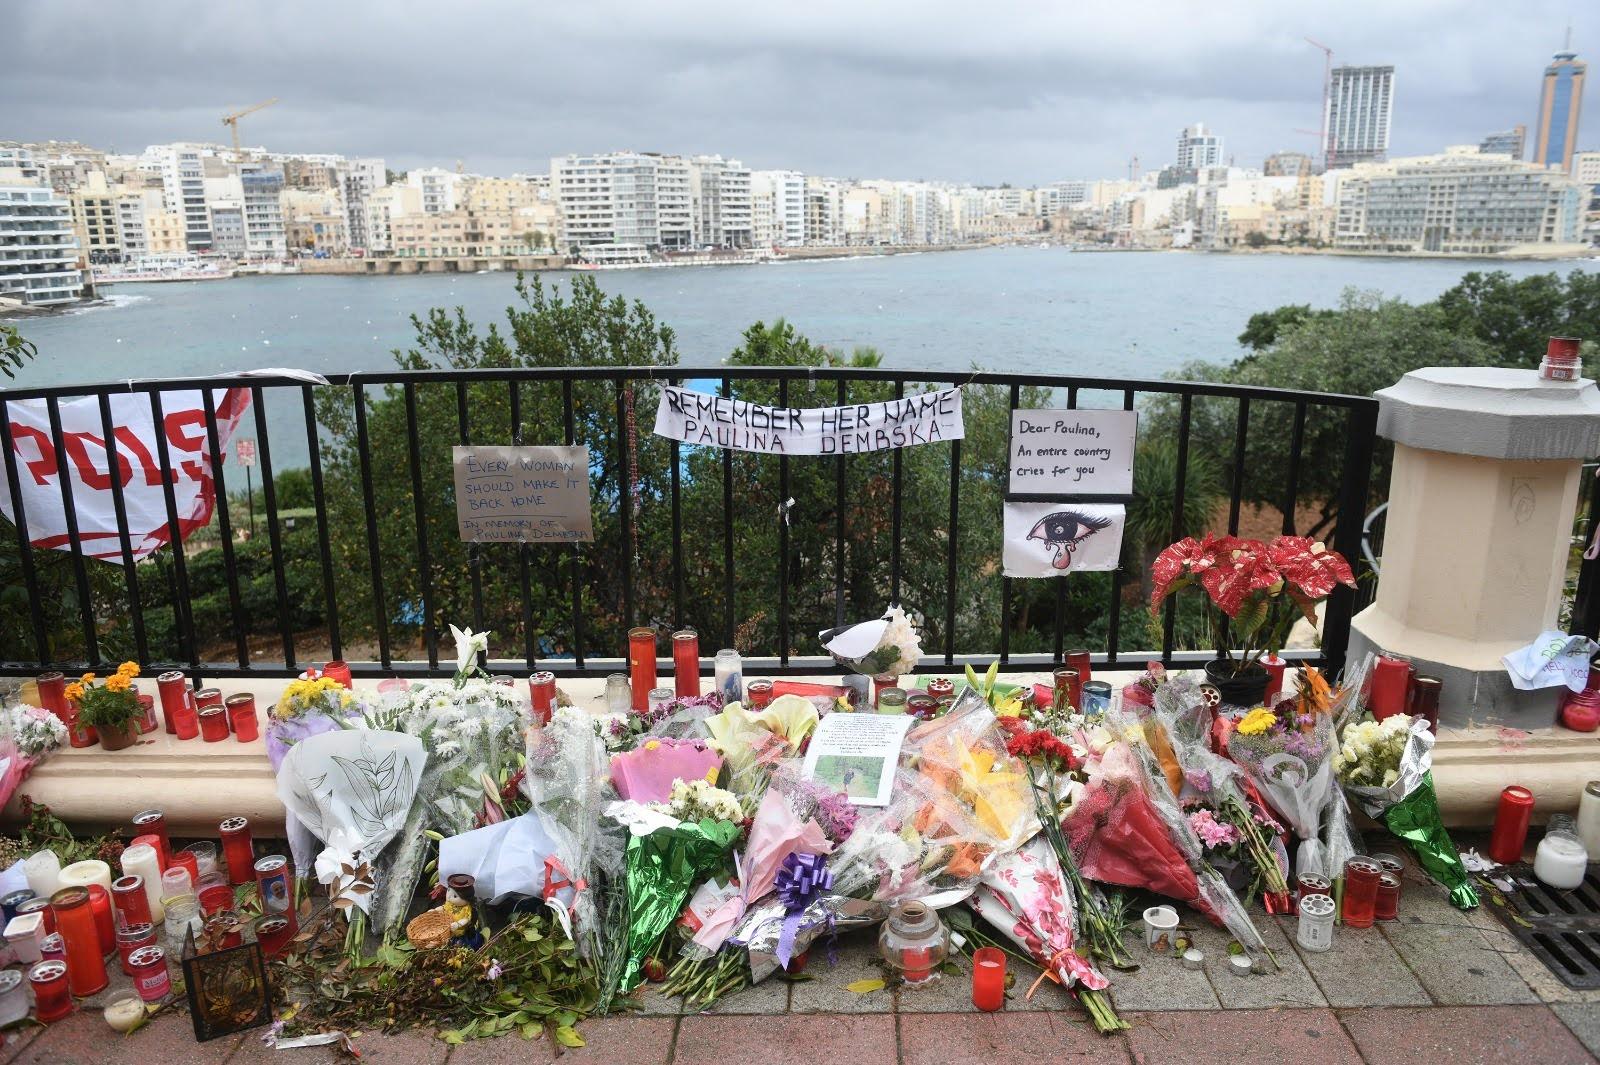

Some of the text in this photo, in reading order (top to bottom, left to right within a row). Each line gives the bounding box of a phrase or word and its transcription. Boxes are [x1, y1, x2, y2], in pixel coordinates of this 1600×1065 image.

[665, 389, 954, 433] REMEMBER HER NAME
[684, 420, 942, 454] PAULINA DEMBSKA
[1019, 420, 1101, 439] Dear Paulina,
[1017, 444, 1111, 461] An entire country
[466, 455, 576, 473] EVERY WOMAN
[1016, 465, 1095, 482] cries for you
[465, 478, 580, 495] SHOULD MAKE IT
[469, 495, 546, 511] BACK HOME
[463, 519, 558, 529] IN MEMORY OF
